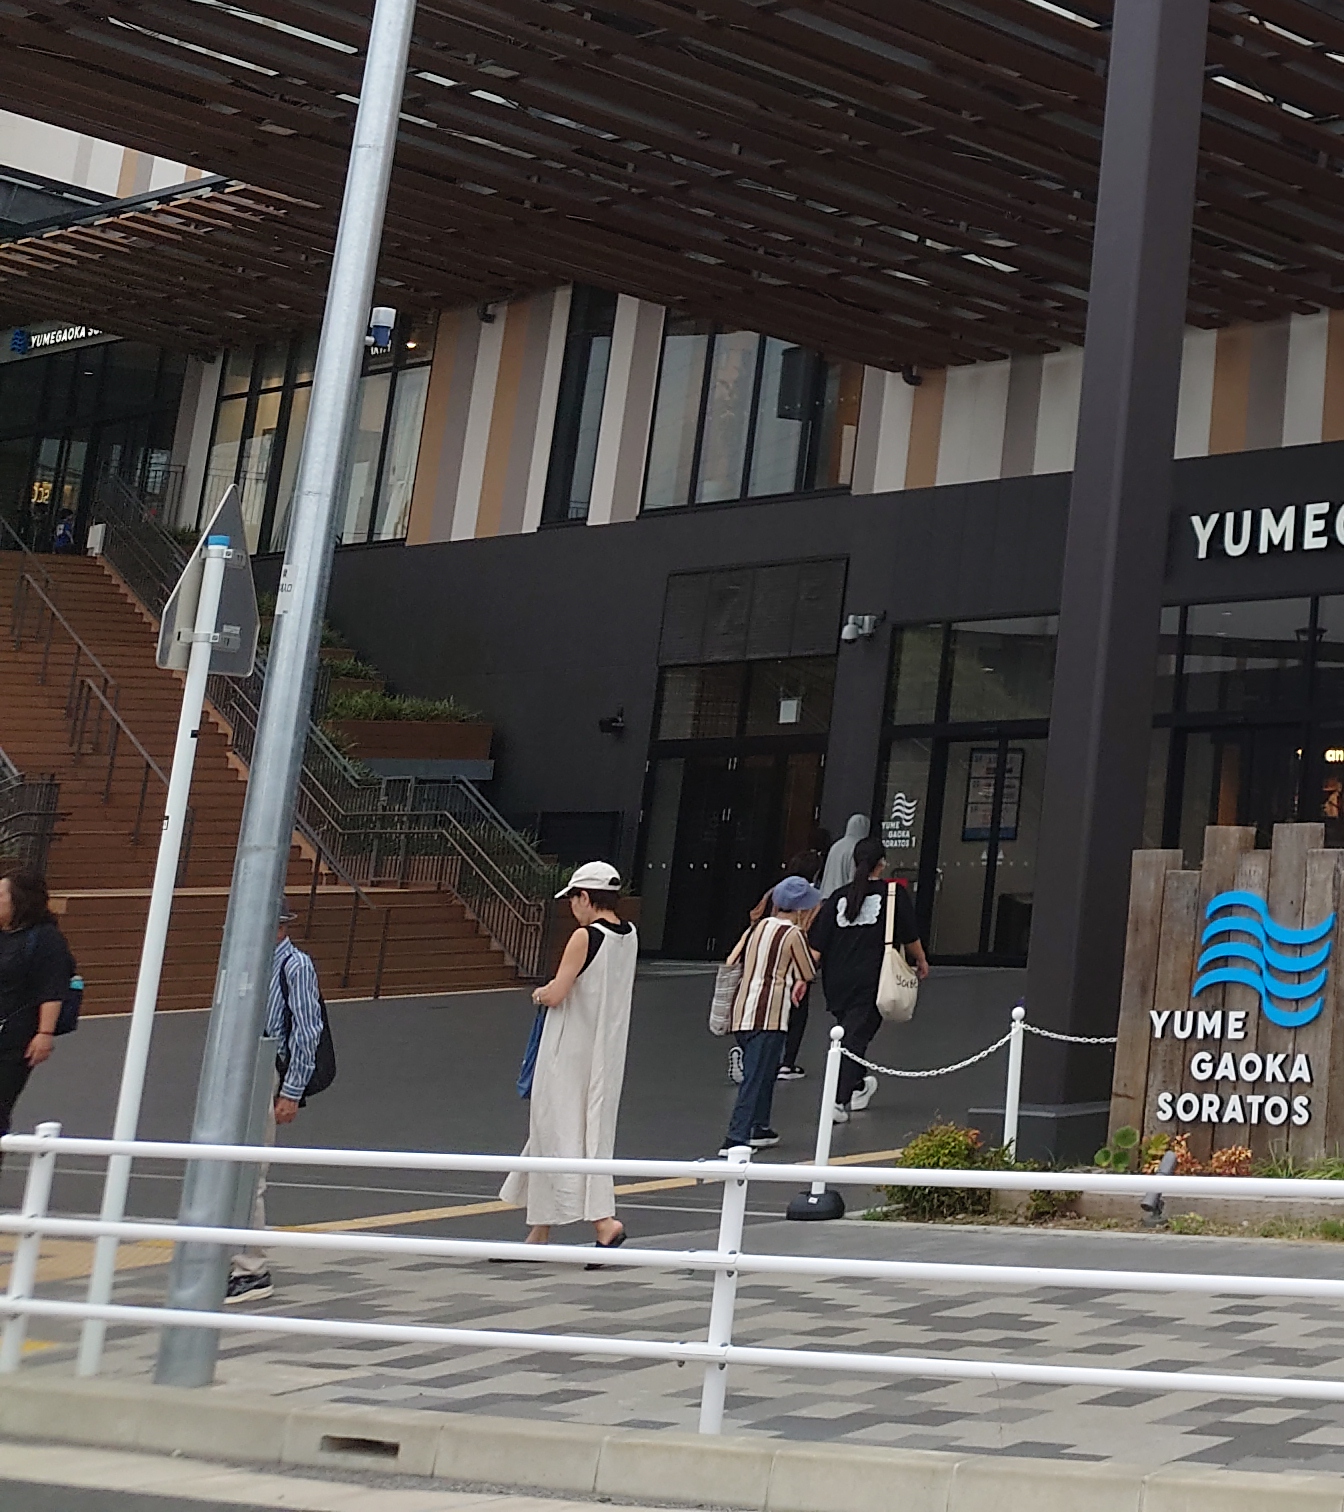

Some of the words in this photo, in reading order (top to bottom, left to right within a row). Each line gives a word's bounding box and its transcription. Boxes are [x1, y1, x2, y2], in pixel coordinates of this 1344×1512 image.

[30, 326, 86, 348] YUMEGAOKA
[882, 821, 900, 829] YUME
[1149, 1010, 1249, 1040] YUME
[1190, 1051, 1313, 1084] GAOKA
[1156, 1092, 1312, 1126] SORATOS
